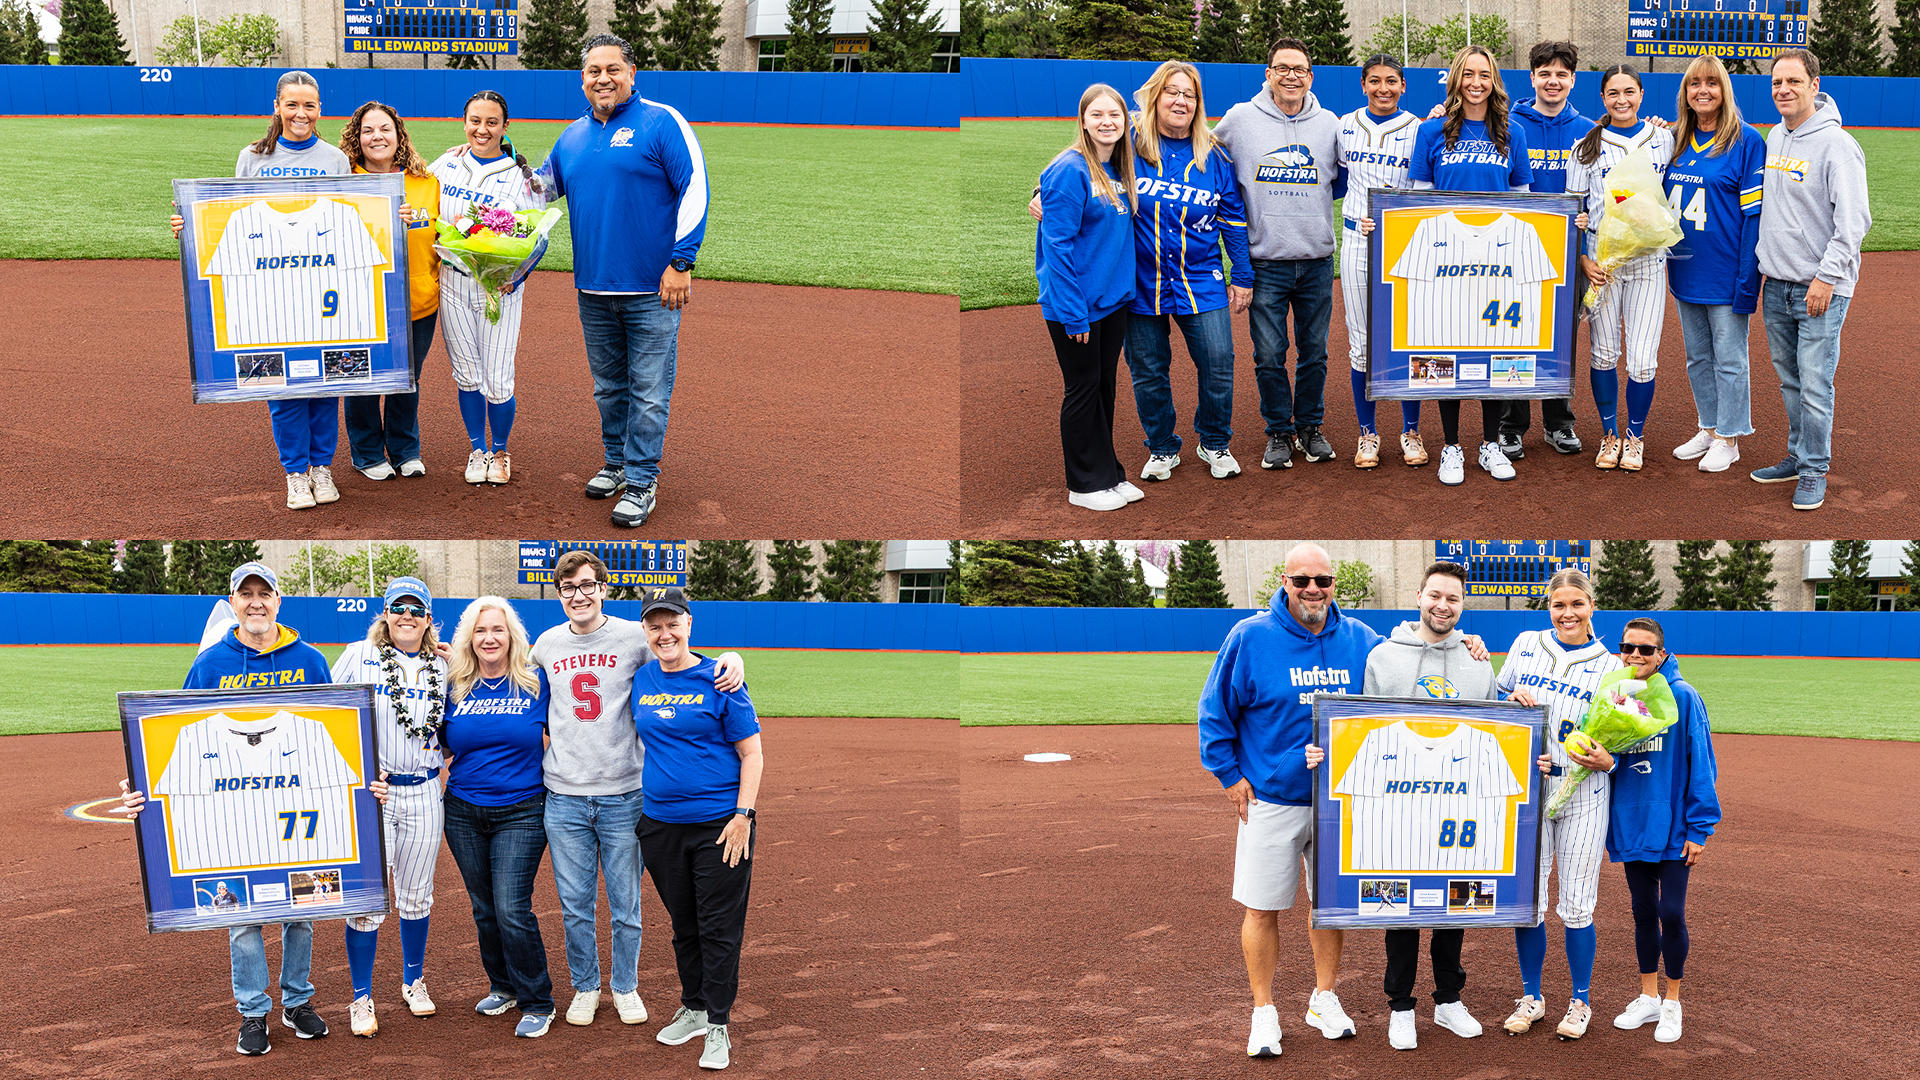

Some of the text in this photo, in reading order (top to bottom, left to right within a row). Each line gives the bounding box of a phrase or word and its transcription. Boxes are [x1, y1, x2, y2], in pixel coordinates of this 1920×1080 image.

[1749, 0, 1756, 12] 0
[346, 14, 515, 27] HAWKS 0 0 0 0
[1630, 17, 1805, 32] HAWKS 0 0 0 0
[349, 26, 515, 38] PRIDE 0 0 0
[1632, 29, 1804, 43] PRIDE 0 0 0
[353, 40, 509, 53] BILL EDWARDS STADIUM
[1636, 44, 1797, 57] BILL EDWARDS STADI
[140, 68, 172, 82] 220
[1345, 150, 1409, 169] HOFSTRA
[1441, 152, 1509, 168] SOFTBALL
[261, 167, 327, 177] HOFSTRA
[1259, 167, 1316, 179] HOFSTRA
[1669, 172, 1704, 184] HOFSTRA
[442, 184, 500, 207] HOFSTR
[1135, 177, 1221, 206] OFSTRA
[256, 253, 336, 270] HOFSTRA
[1435, 264, 1513, 278] HOFSTRA
[321, 289, 339, 318] 9
[1481, 299, 1522, 329] 44
[521, 547, 684, 560] HAWKS 0 0 0 0
[1449, 544, 1545, 556] 09 0 0 0
[523, 559, 683, 570] PRIDE 0 0 0
[1464, 561, 1470, 571] 0
[1556, 562, 1562, 572] 0
[1583, 563, 1588, 572] 0
[527, 572, 554, 582] BILL
[622, 574, 677, 584] STADIUM
[391, 582, 424, 594] HOFSTRA
[1471, 585, 1528, 595] EDWARDS
[337, 599, 367, 612] 220
[553, 654, 618, 674] STEVENS
[219, 668, 305, 689] HOFSTRA
[1290, 666, 1351, 686] Hofstra
[1519, 673, 1592, 704] HOFSTRA
[474, 698, 531, 707] HOFSTRA
[569, 671, 603, 722] S
[639, 693, 704, 706] HOFSTRA
[468, 707, 523, 715] SOFTBALL
[214, 774, 301, 792] HOFSTRA
[1385, 780, 1468, 795] HOFSTRA
[278, 809, 319, 841] 77
[1438, 818, 1477, 850] 88
